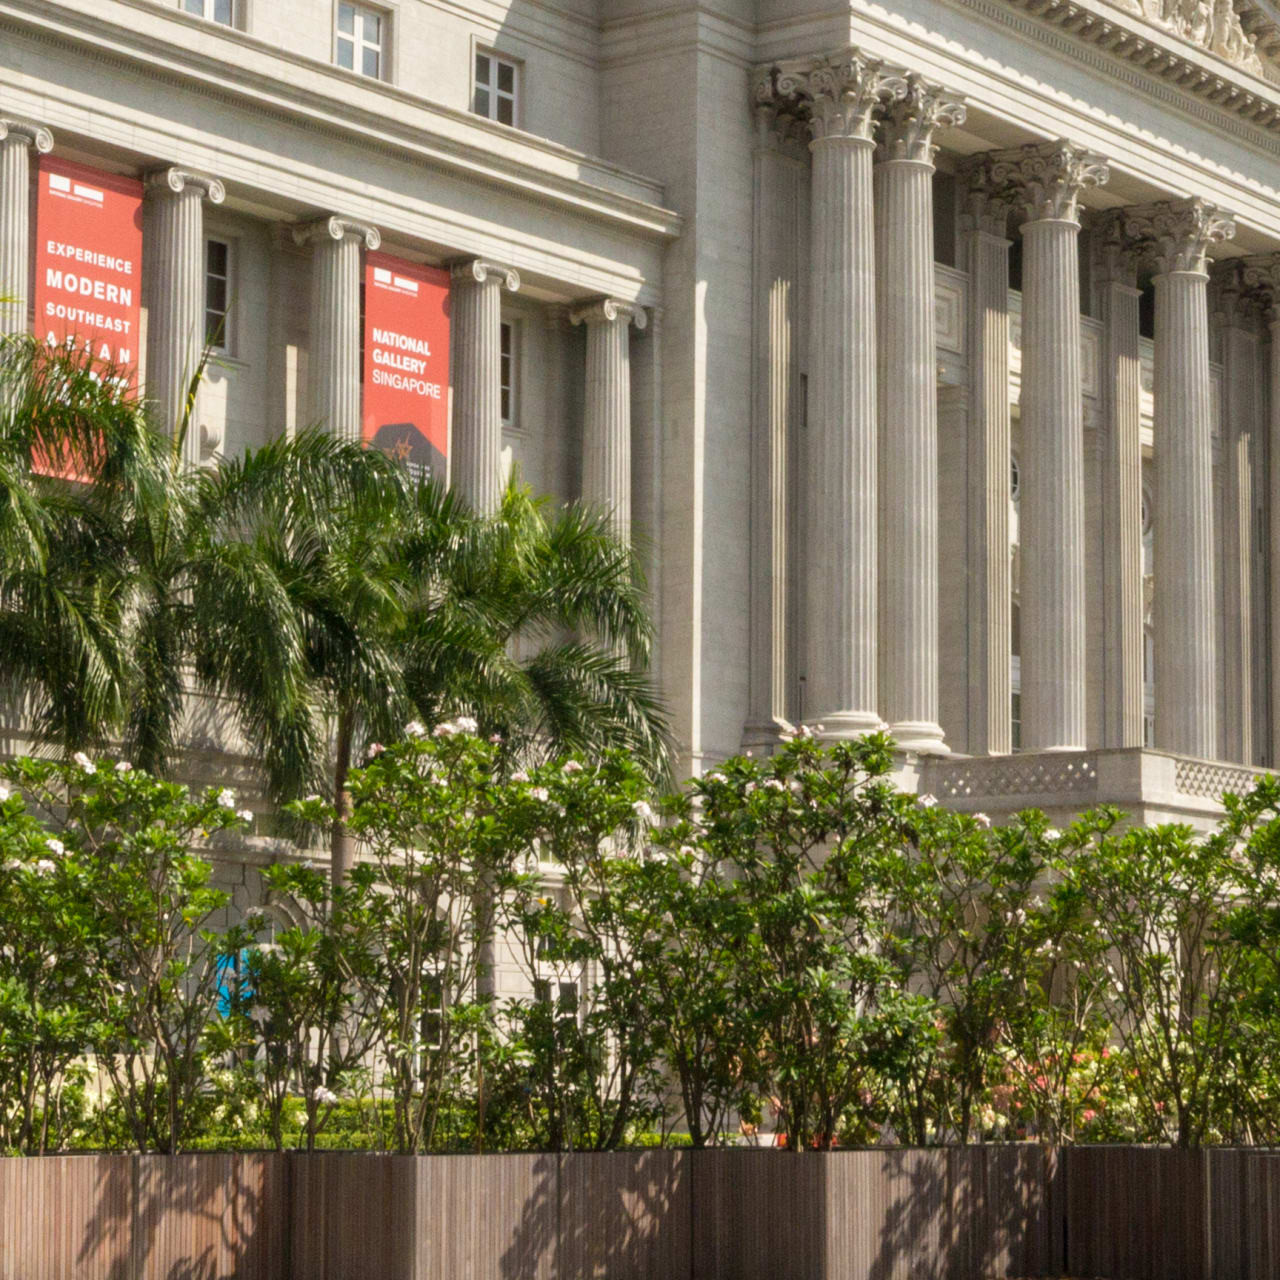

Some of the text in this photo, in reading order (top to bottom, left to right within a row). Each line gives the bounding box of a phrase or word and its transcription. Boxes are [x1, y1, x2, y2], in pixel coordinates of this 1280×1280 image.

[46, 240, 133, 275] EXPERIENCE
[46, 268, 132, 307] MODERN
[46, 302, 131, 335] SOUTHEAST
[45, 330, 131, 365] ASIAN
[372, 328, 431, 356] NATIONAL
[372, 348, 427, 375] GALLERY
[372, 368, 441, 399] SINGAPORE
